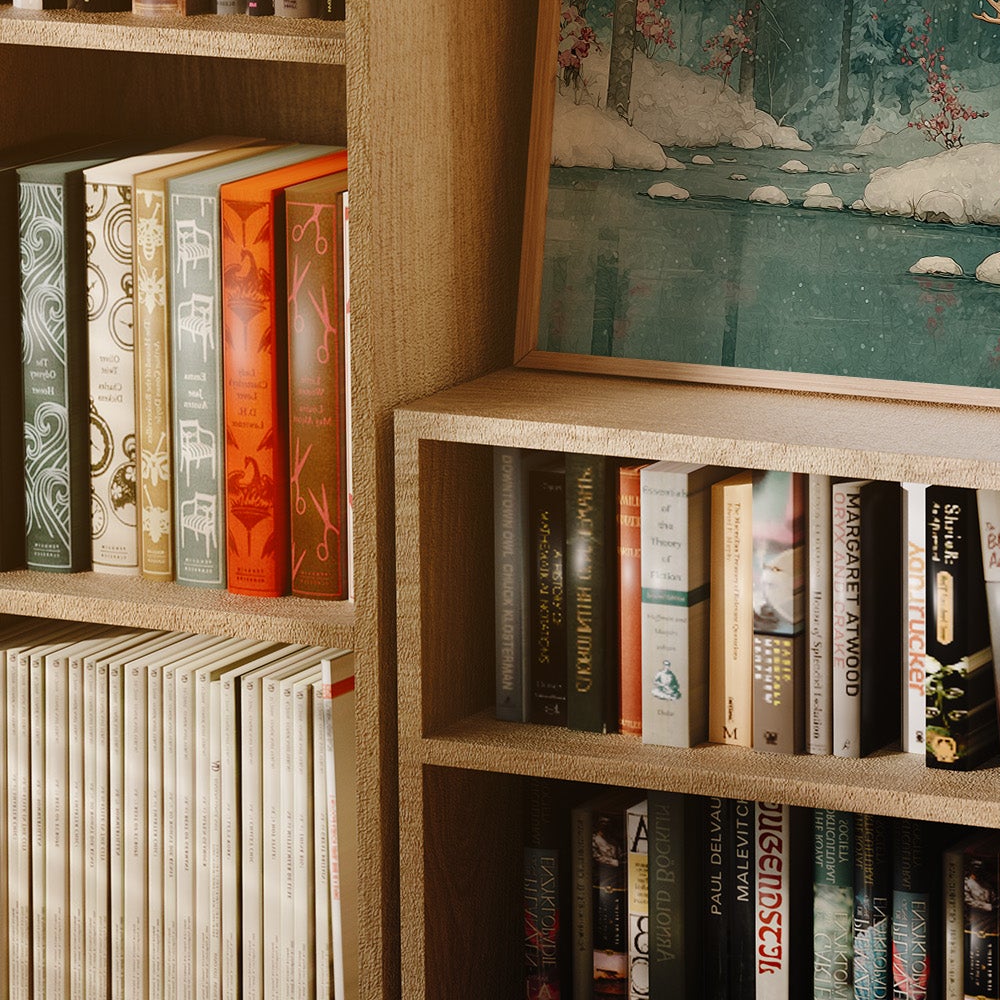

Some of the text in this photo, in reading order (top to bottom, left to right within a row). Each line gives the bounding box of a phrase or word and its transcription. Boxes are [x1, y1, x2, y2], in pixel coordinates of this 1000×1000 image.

[501, 455, 513, 691] DOWNTOWN OWL CHUCK KLOSTERMAN
[651, 537, 682, 550] Theory
[833, 492, 846, 669] ORYX AND CRAKE
[846, 493, 860, 698] MARGARET ATWOOD
[711, 798, 722, 916] PAUL DELVAU
